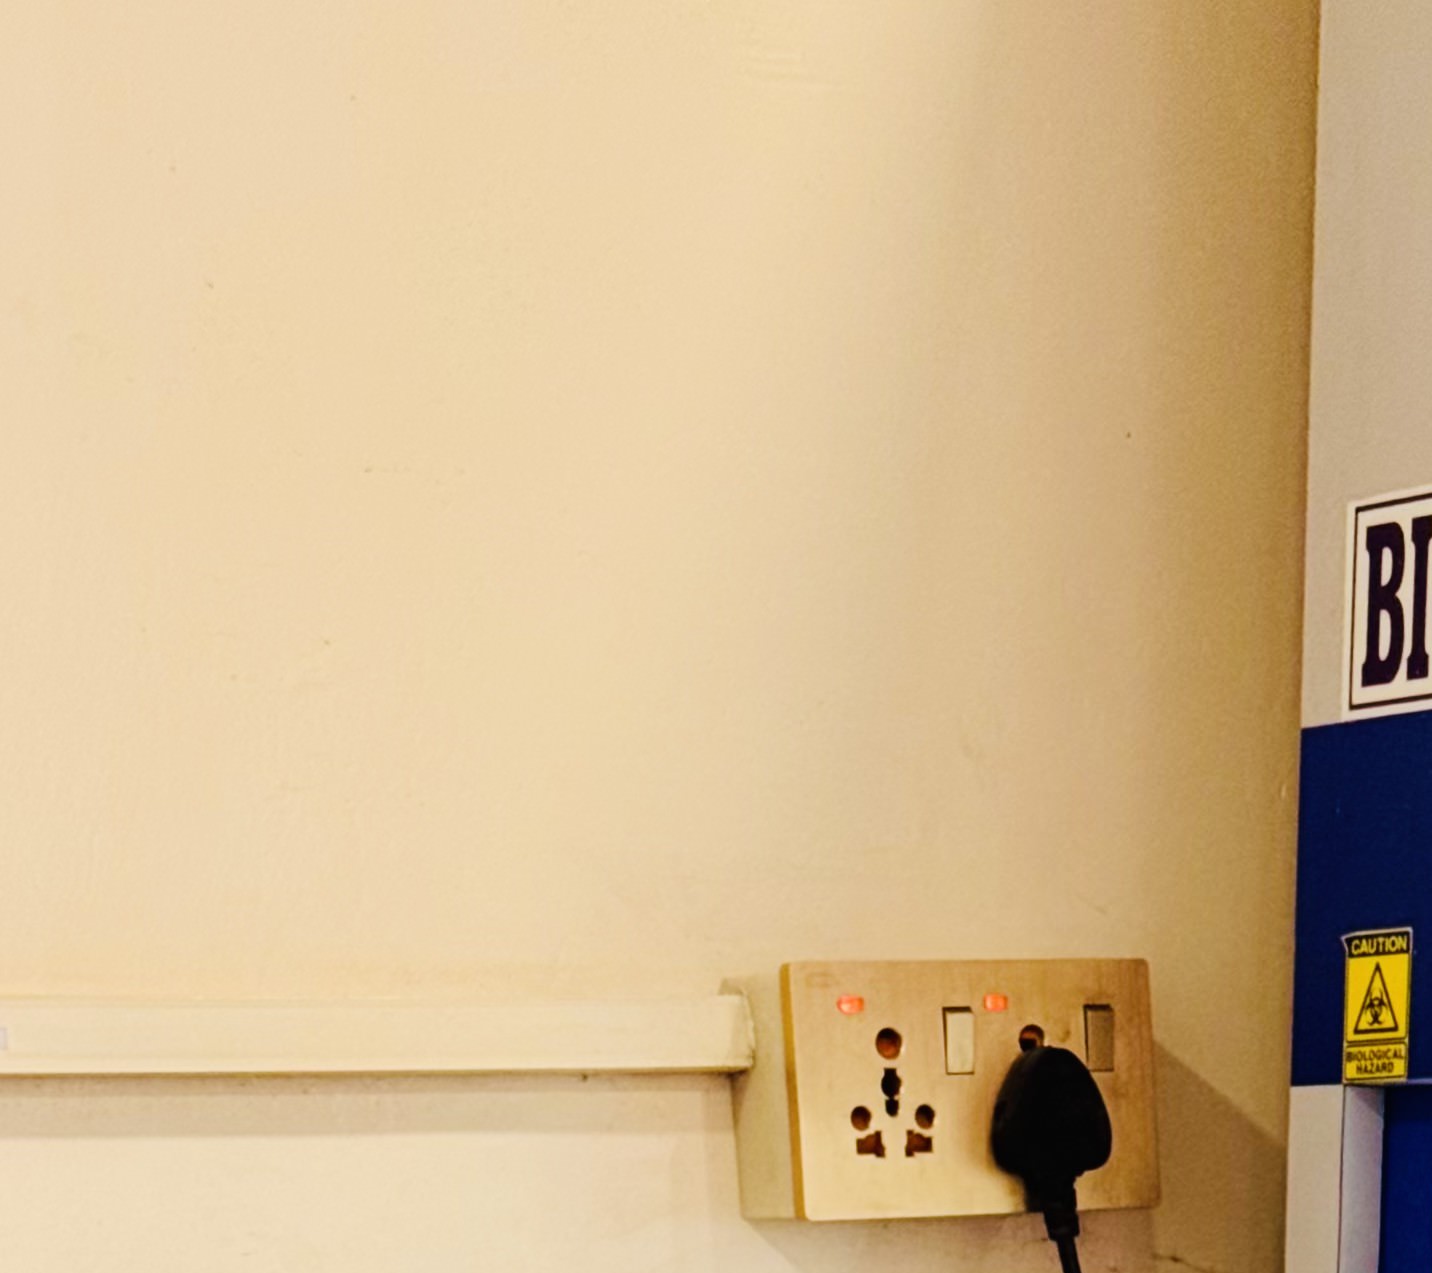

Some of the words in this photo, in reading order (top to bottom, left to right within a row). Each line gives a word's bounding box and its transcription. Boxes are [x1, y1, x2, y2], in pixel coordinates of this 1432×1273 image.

[1351, 934, 1407, 955] CAUTION
[1346, 1047, 1404, 1062] BIOLOGICAL
[1356, 1061, 1394, 1074] HAZARD
